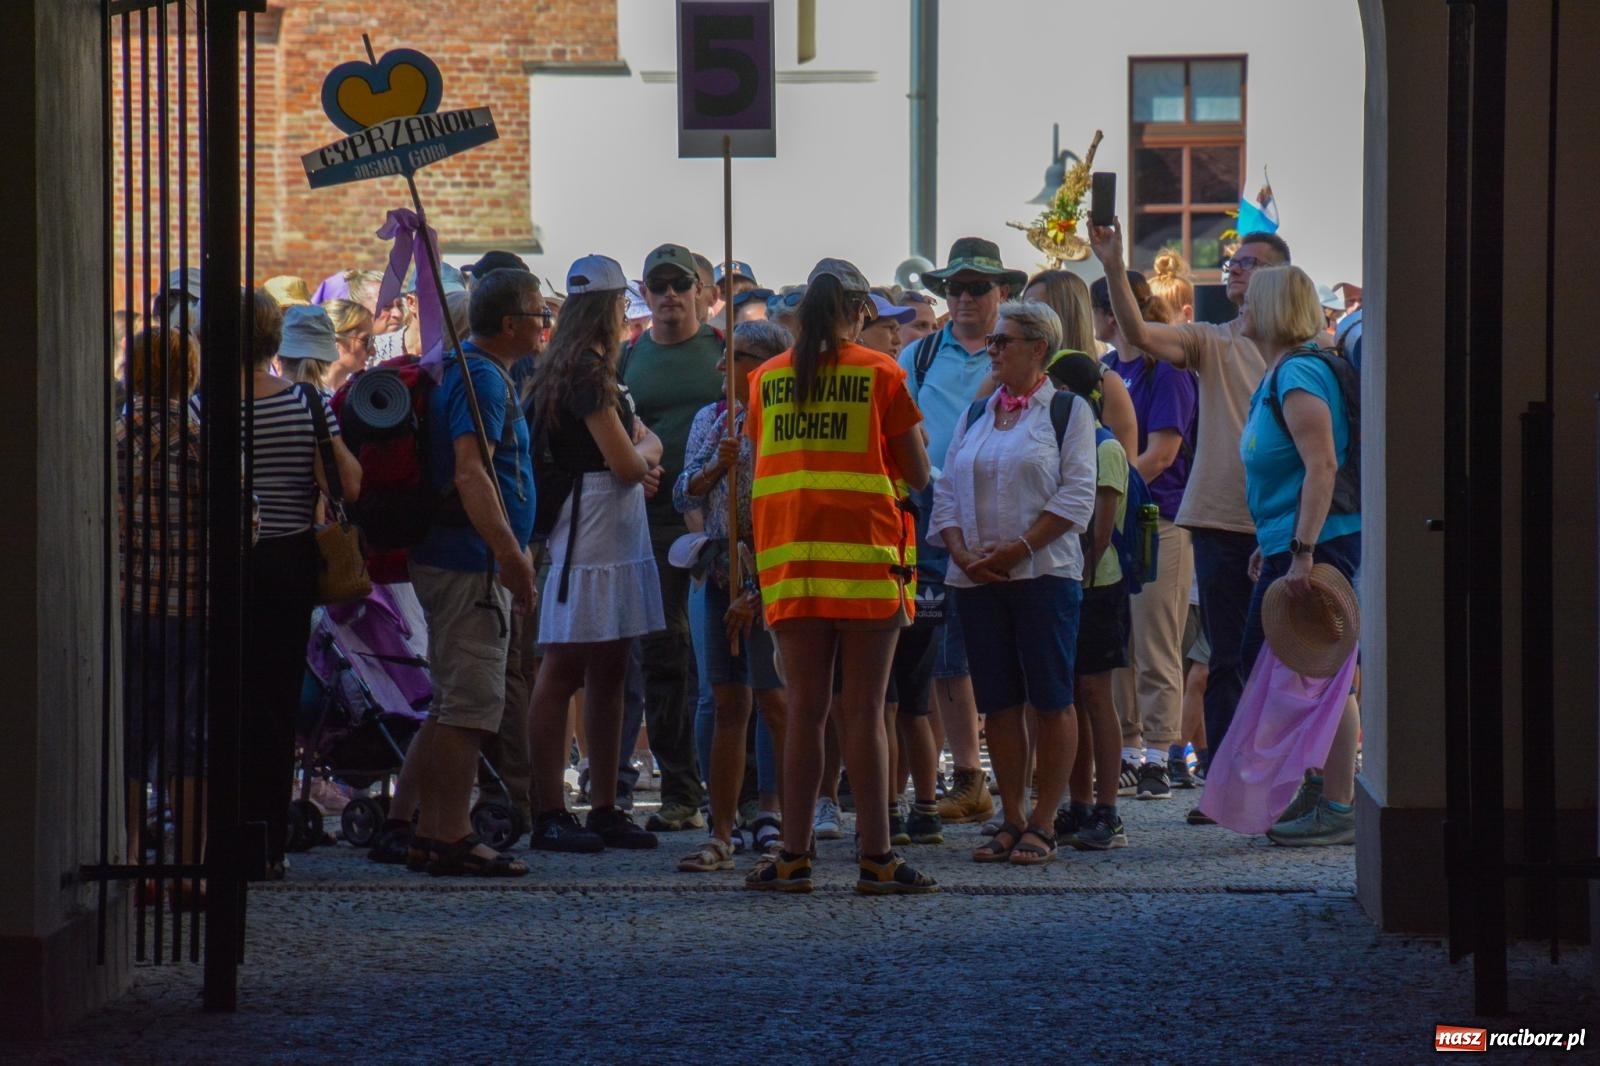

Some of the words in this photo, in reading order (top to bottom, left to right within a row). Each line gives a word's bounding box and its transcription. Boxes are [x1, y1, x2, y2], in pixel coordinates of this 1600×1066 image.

[694, 15, 758, 118] 5
[762, 375, 871, 408] KIERWANIE
[774, 411, 848, 442] RUCHEM
